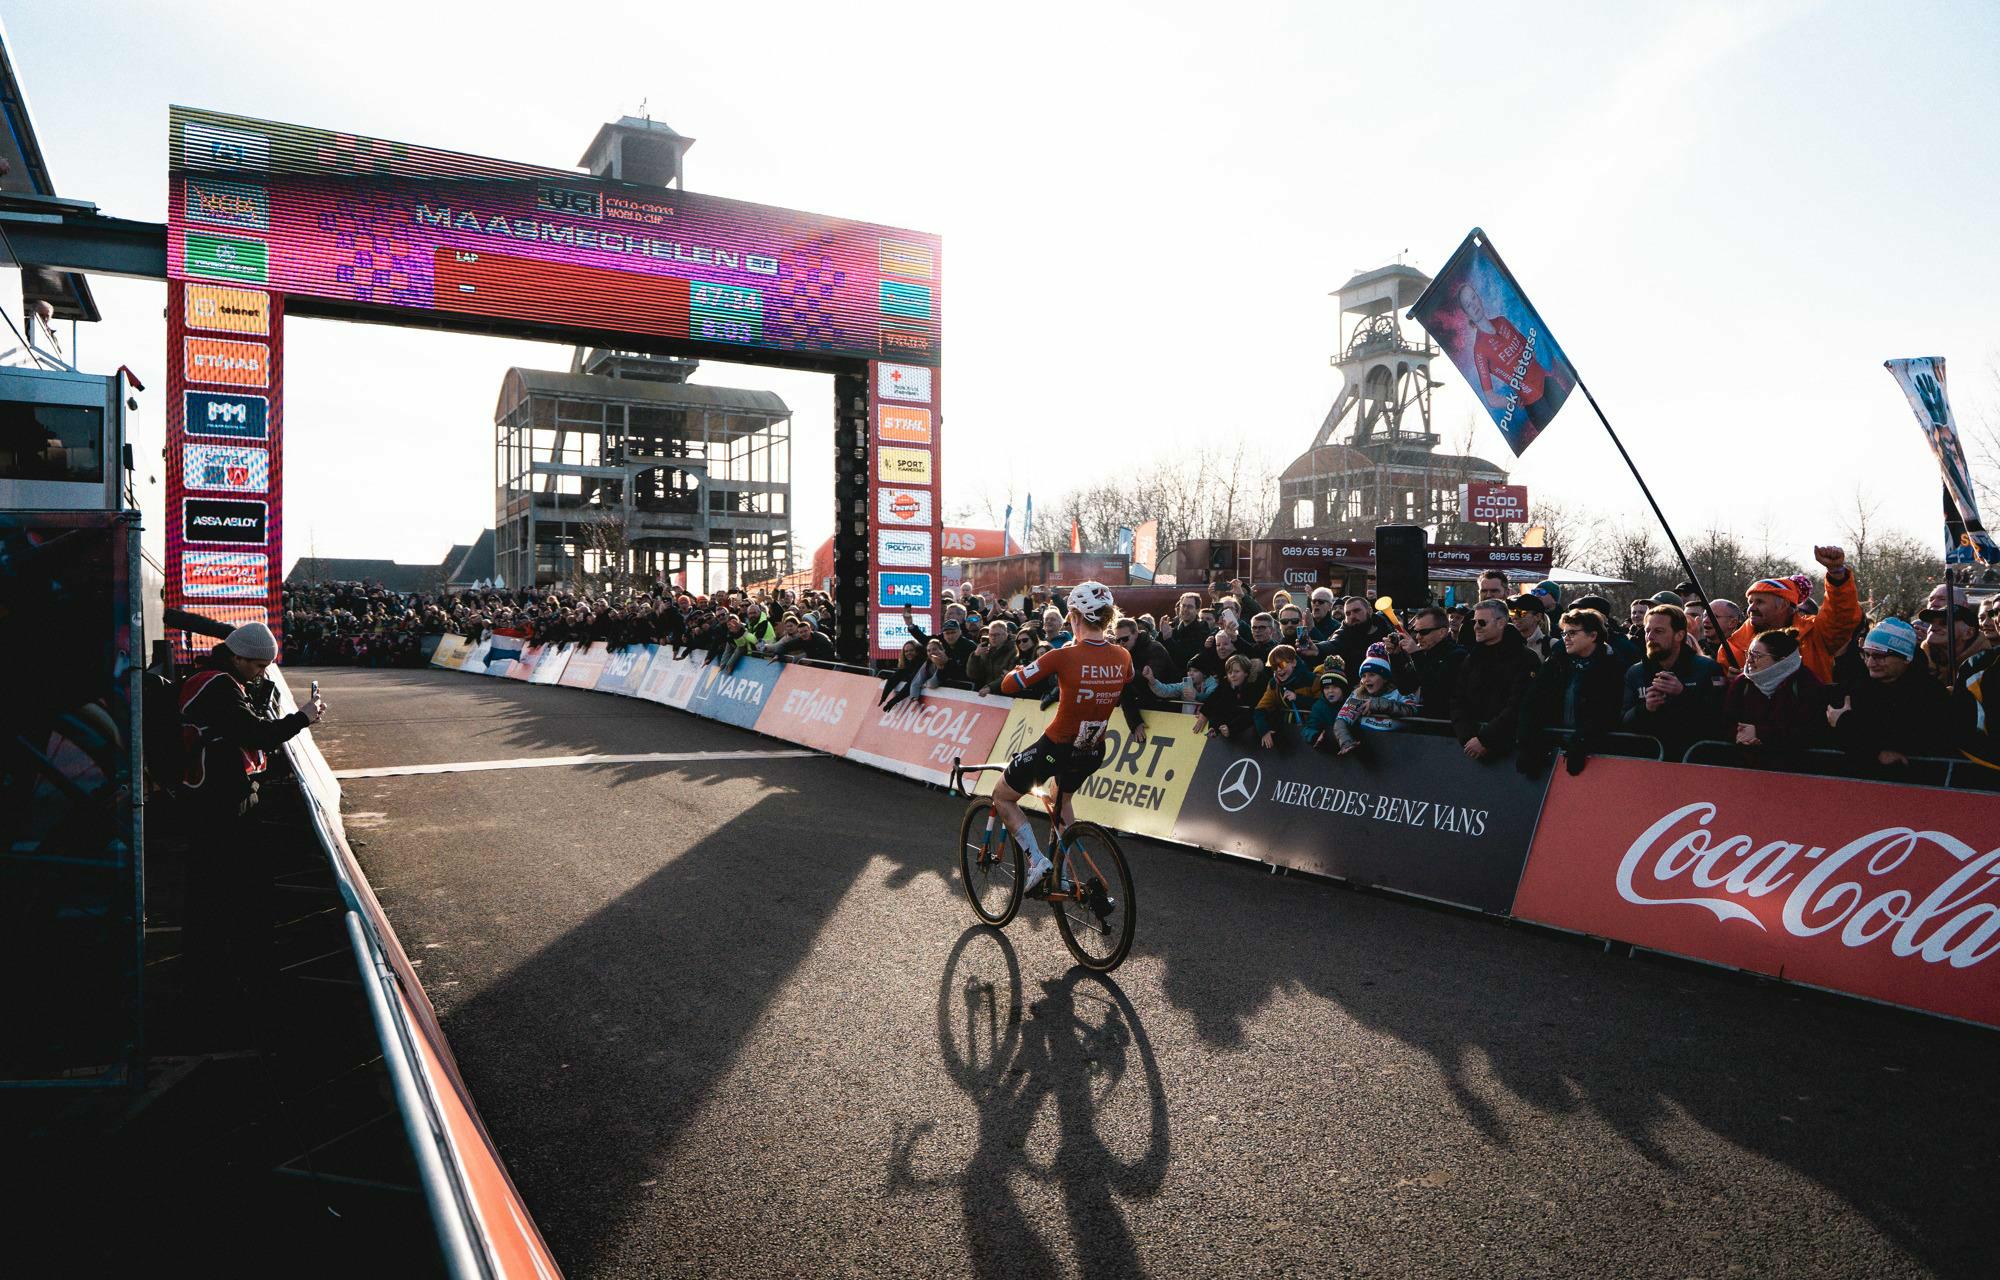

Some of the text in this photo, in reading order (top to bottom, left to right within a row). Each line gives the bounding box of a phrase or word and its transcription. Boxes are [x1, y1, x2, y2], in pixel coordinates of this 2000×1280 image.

[415, 203, 740, 268] MAASMECHELEN
[456, 250, 478, 263] LAP
[220, 306, 260, 317] telenet
[1500, 392, 1518, 432] Puck
[1510, 327, 1537, 391] Pieterse
[885, 417, 927, 432] STIHL
[204, 452, 248, 466] simac
[1477, 495, 1517, 506] FOOD
[1474, 507, 1523, 519] COURT
[193, 516, 258, 528] ASSA ABLOY
[1282, 546, 1348, 557] 089/65 96 27
[1438, 551, 1470, 561] Catering
[1489, 552, 1544, 561] 089/65 96 27
[192, 564, 257, 577] BINGOAL
[1284, 567, 1318, 585] Cristal
[894, 584, 924, 595] MAES
[1081, 665, 1123, 679] FENIX
[717, 674, 765, 706] VARTA
[1087, 725, 1101, 741] 7
[928, 742, 967, 765] FUN
[1100, 729, 1176, 782] ORT.
[1271, 780, 1489, 836] MERCEDES-BENZ VANS
[1616, 801, 2000, 968] Coca-Cola
